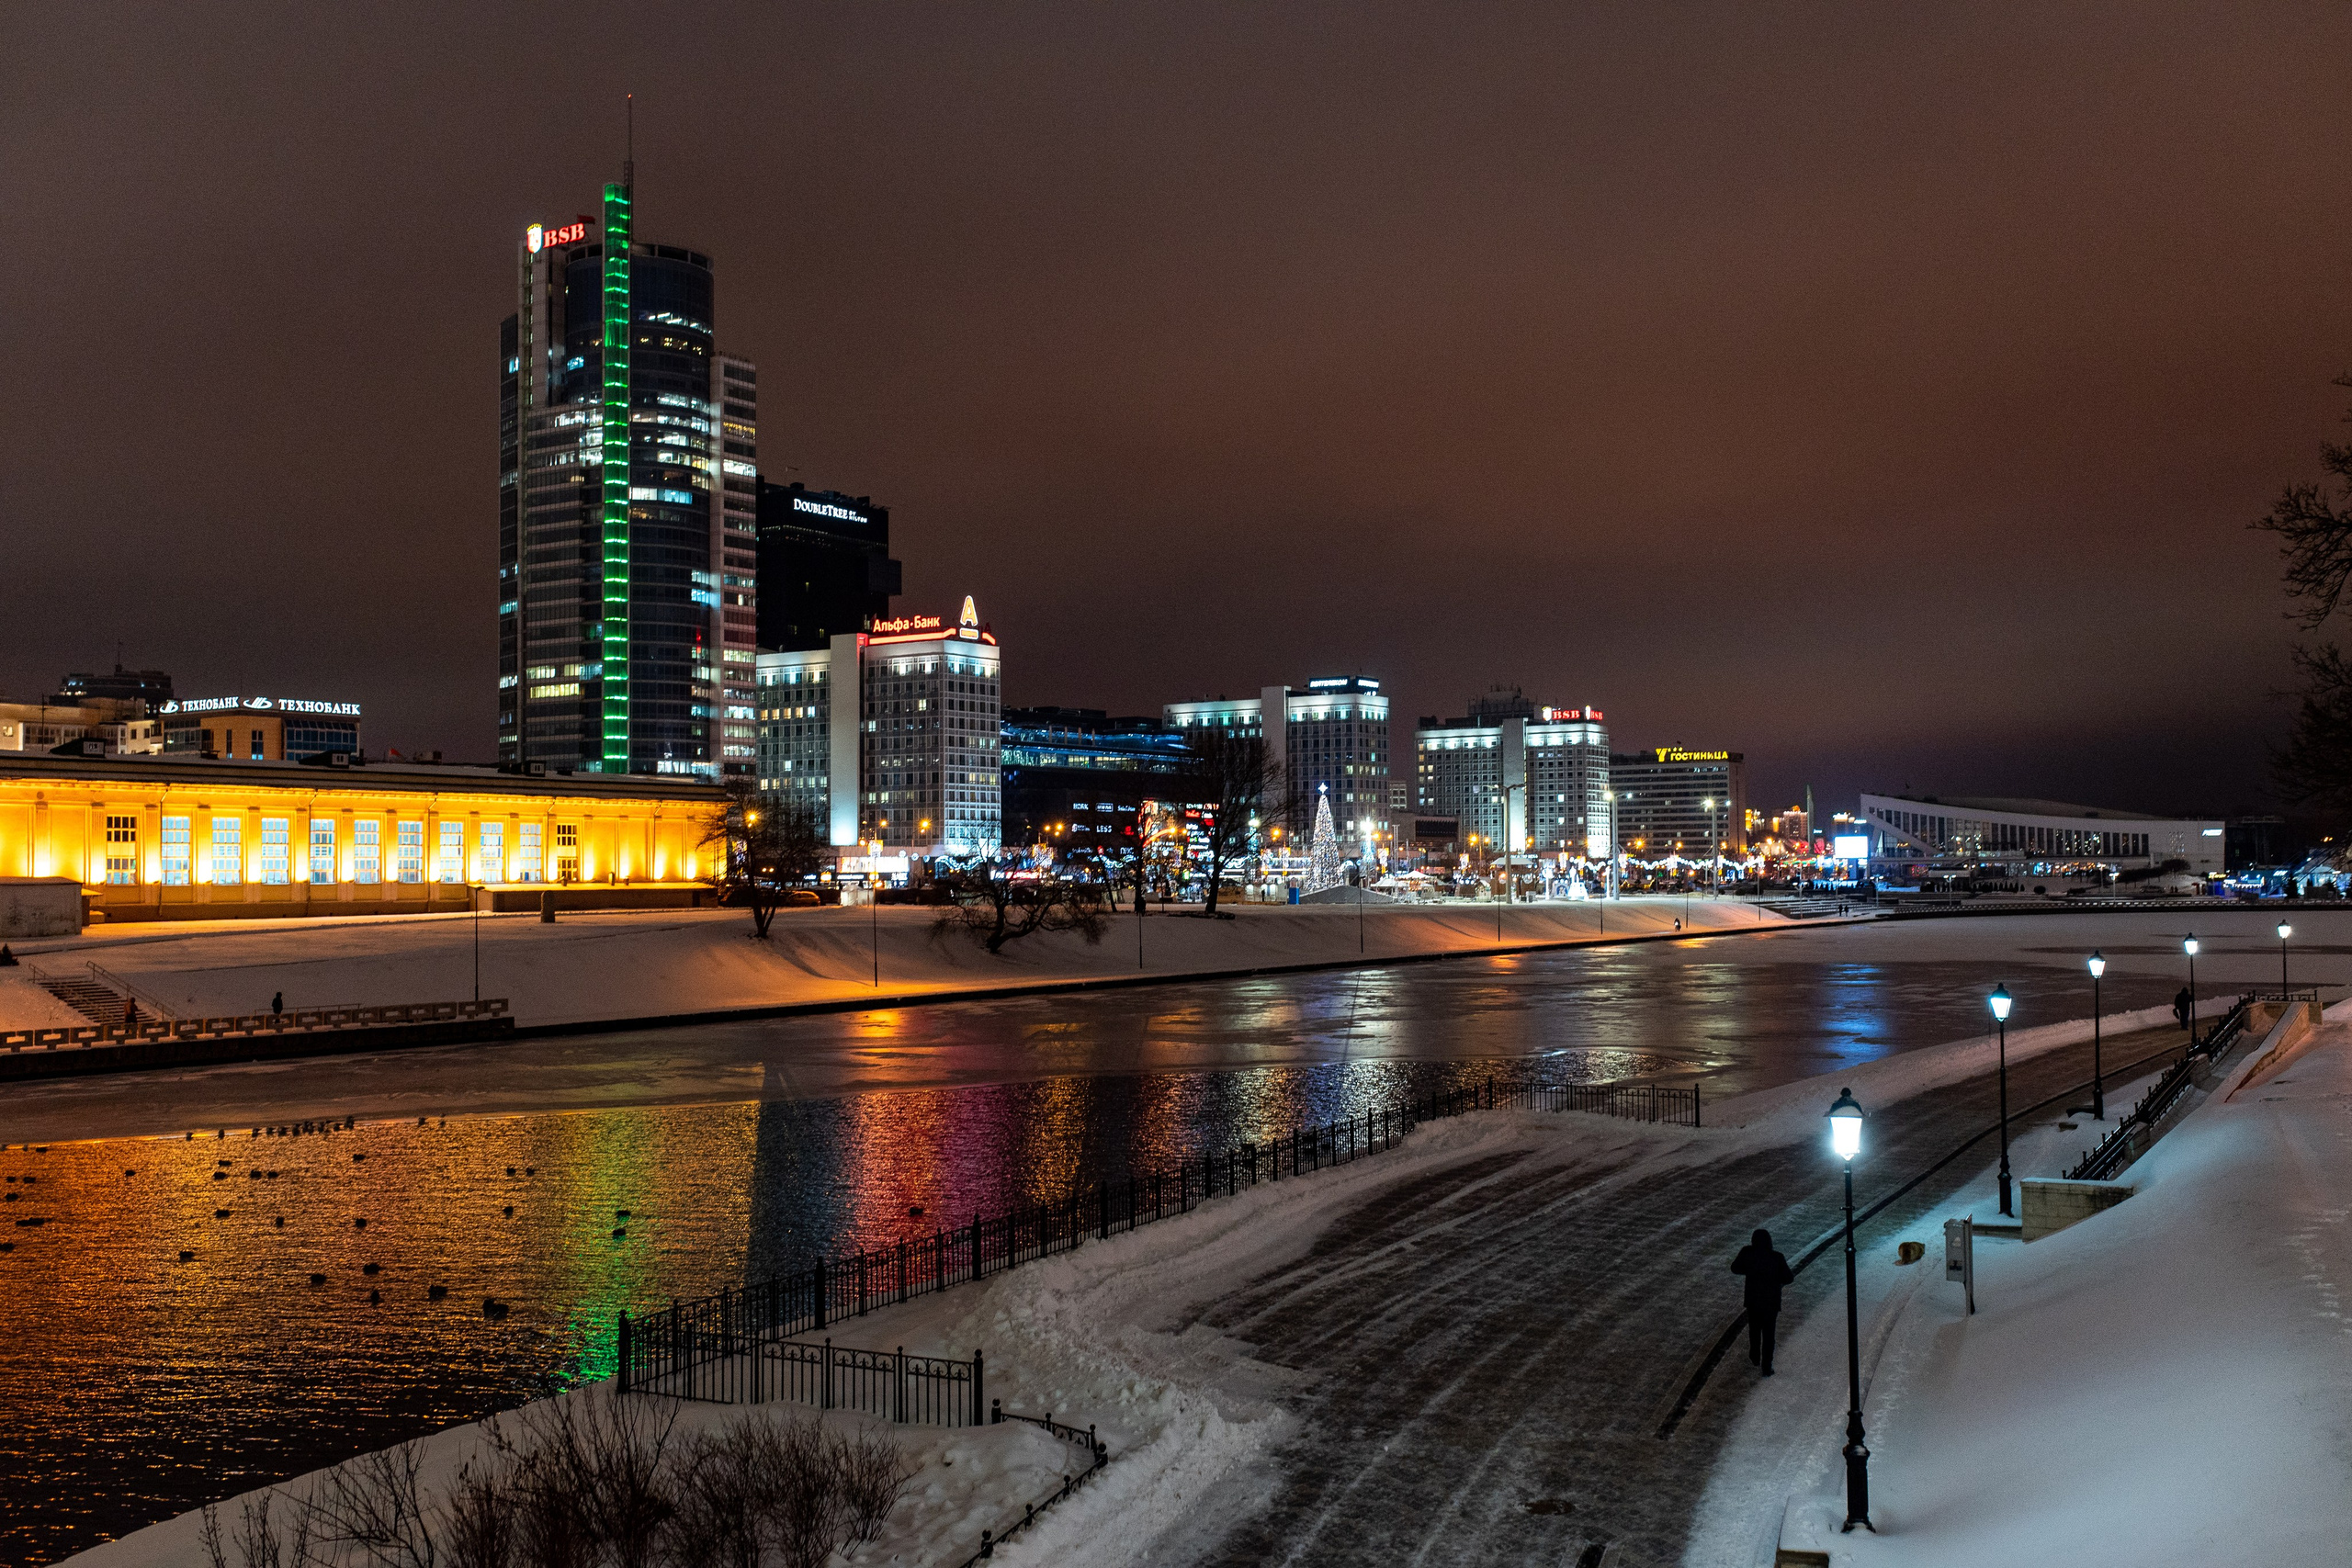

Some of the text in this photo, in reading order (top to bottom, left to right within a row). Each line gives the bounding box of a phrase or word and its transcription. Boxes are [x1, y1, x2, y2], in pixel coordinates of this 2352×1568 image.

[543, 223, 585, 248] BSB
[182, 696, 240, 713] ТЕХНОБАНК
[278, 698, 361, 716] ТЕХНОБАНК
[1552, 709, 1580, 720] BSB
[1590, 709, 1604, 721] BSB
[1670, 750, 1729, 761] ГОСТИНИЦА
